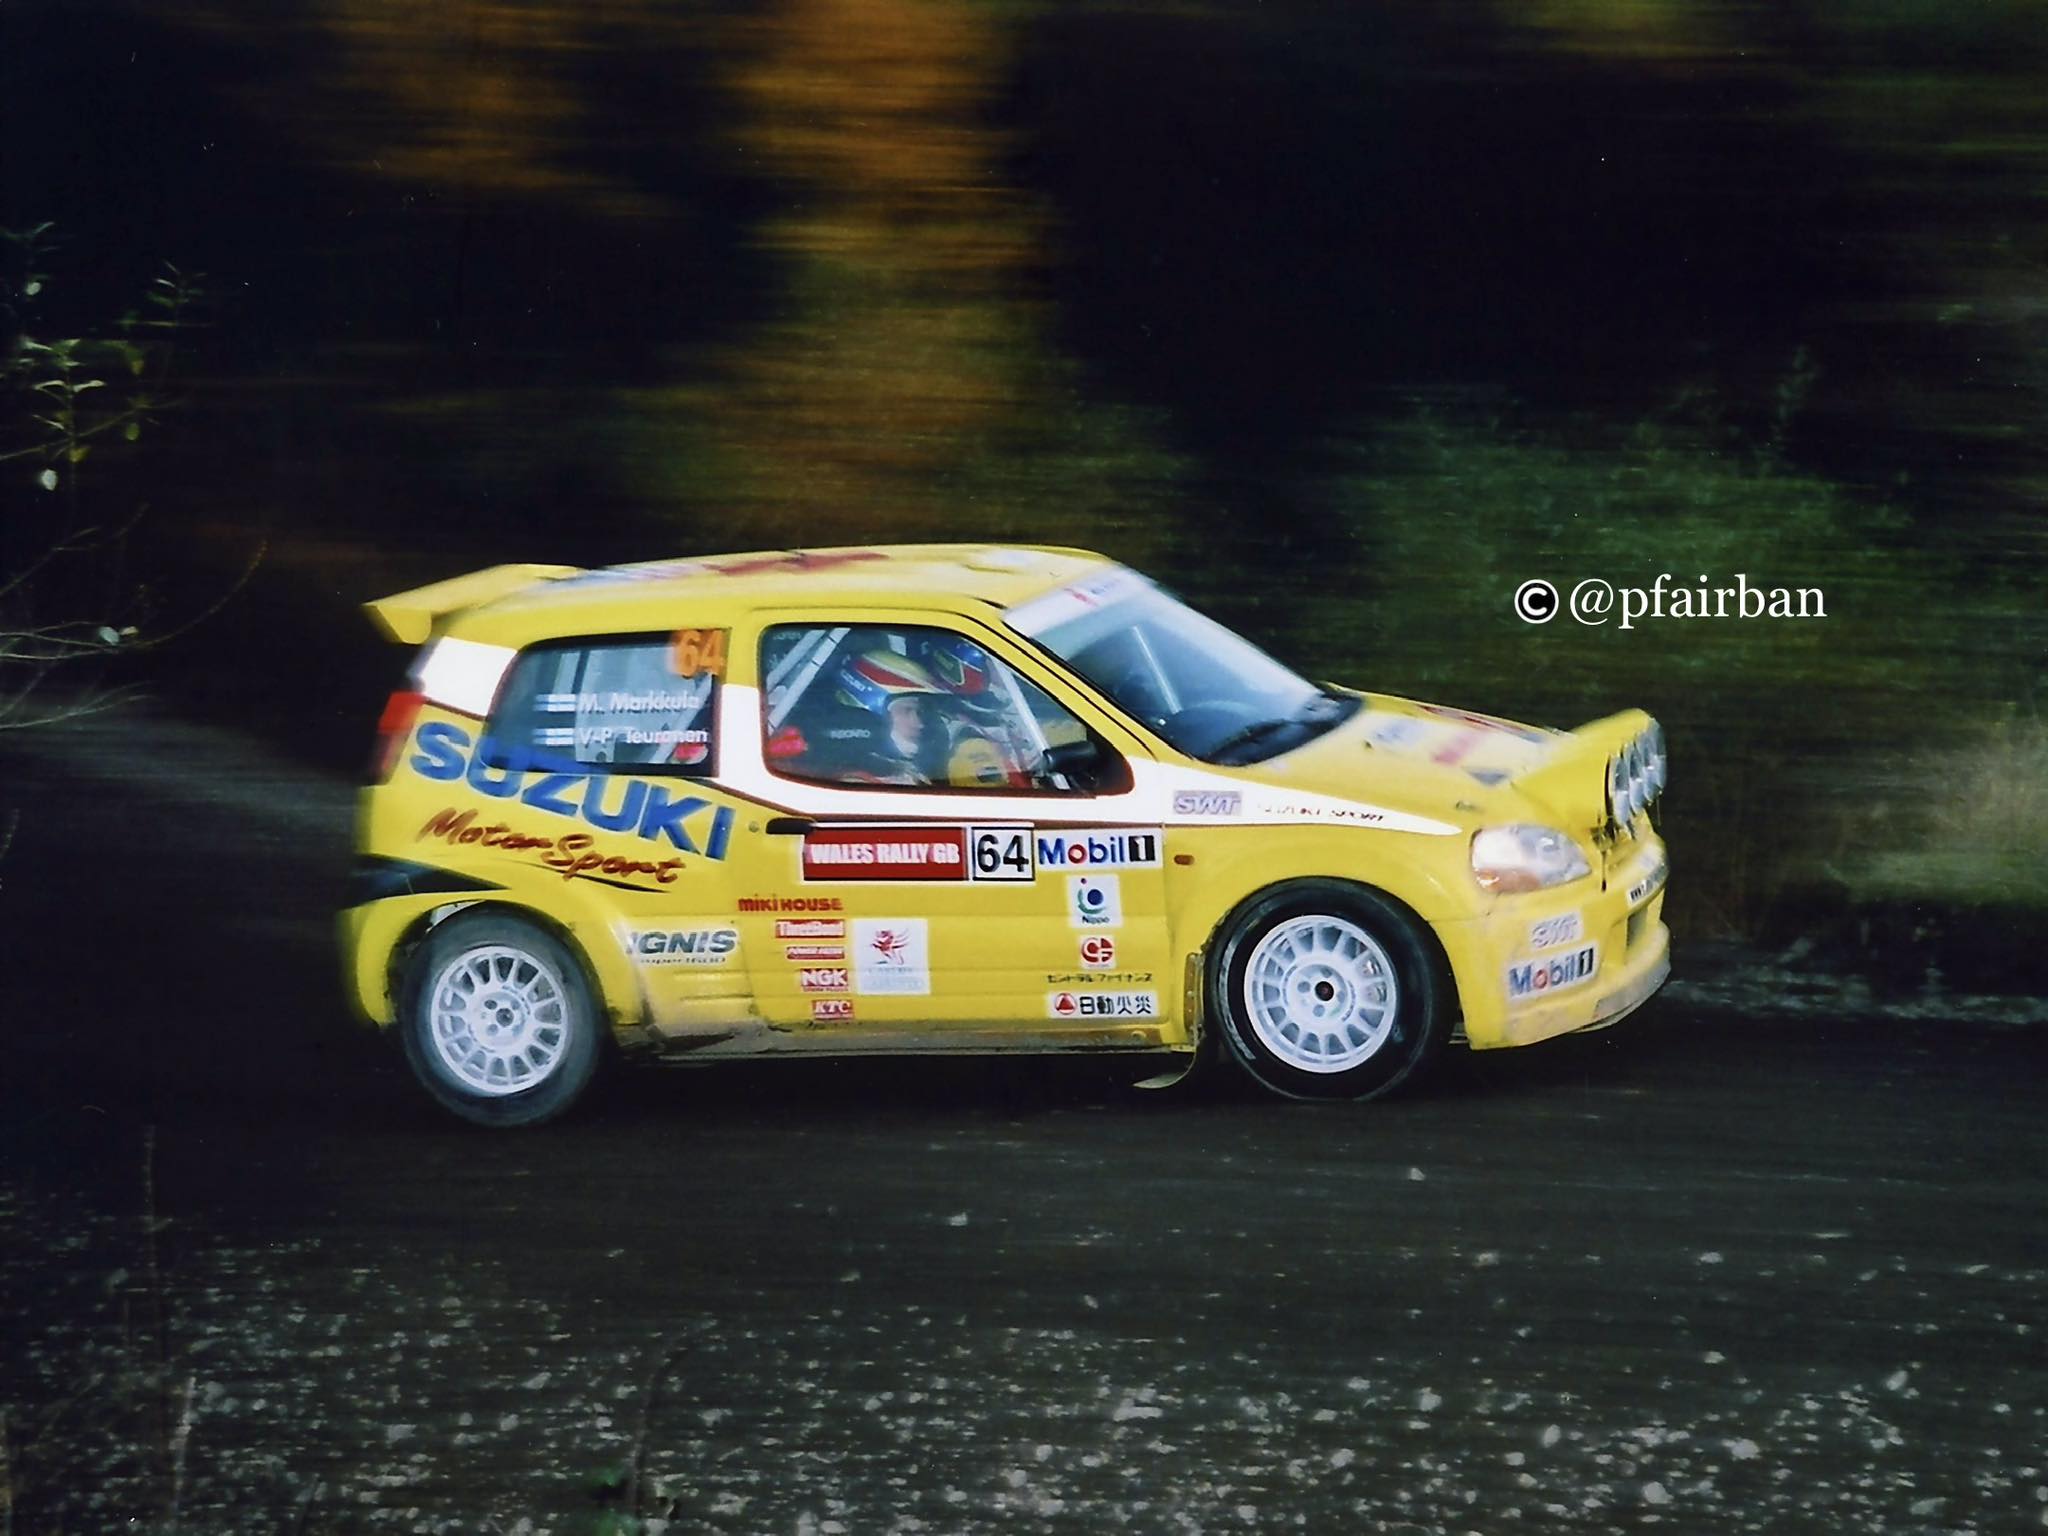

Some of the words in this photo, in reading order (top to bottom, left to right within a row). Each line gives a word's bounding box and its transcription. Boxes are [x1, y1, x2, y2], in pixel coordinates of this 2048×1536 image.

[672, 629, 724, 678] 64
[609, 690, 703, 713] Markkula
[409, 721, 736, 861] SUZUKI
[1174, 791, 1241, 815] SWT
[810, 843, 874, 865] WALES
[877, 842, 930, 864] RALLY
[934, 842, 960, 864] GB
[976, 834, 1030, 873] 64
[1037, 835, 1126, 868] Mobil
[626, 930, 737, 955] IGNIS
[801, 969, 848, 986] NGK
[1509, 954, 1576, 997] Mobil
[814, 1001, 850, 1014] KTC
[1079, 996, 1152, 1015] 日動火災
